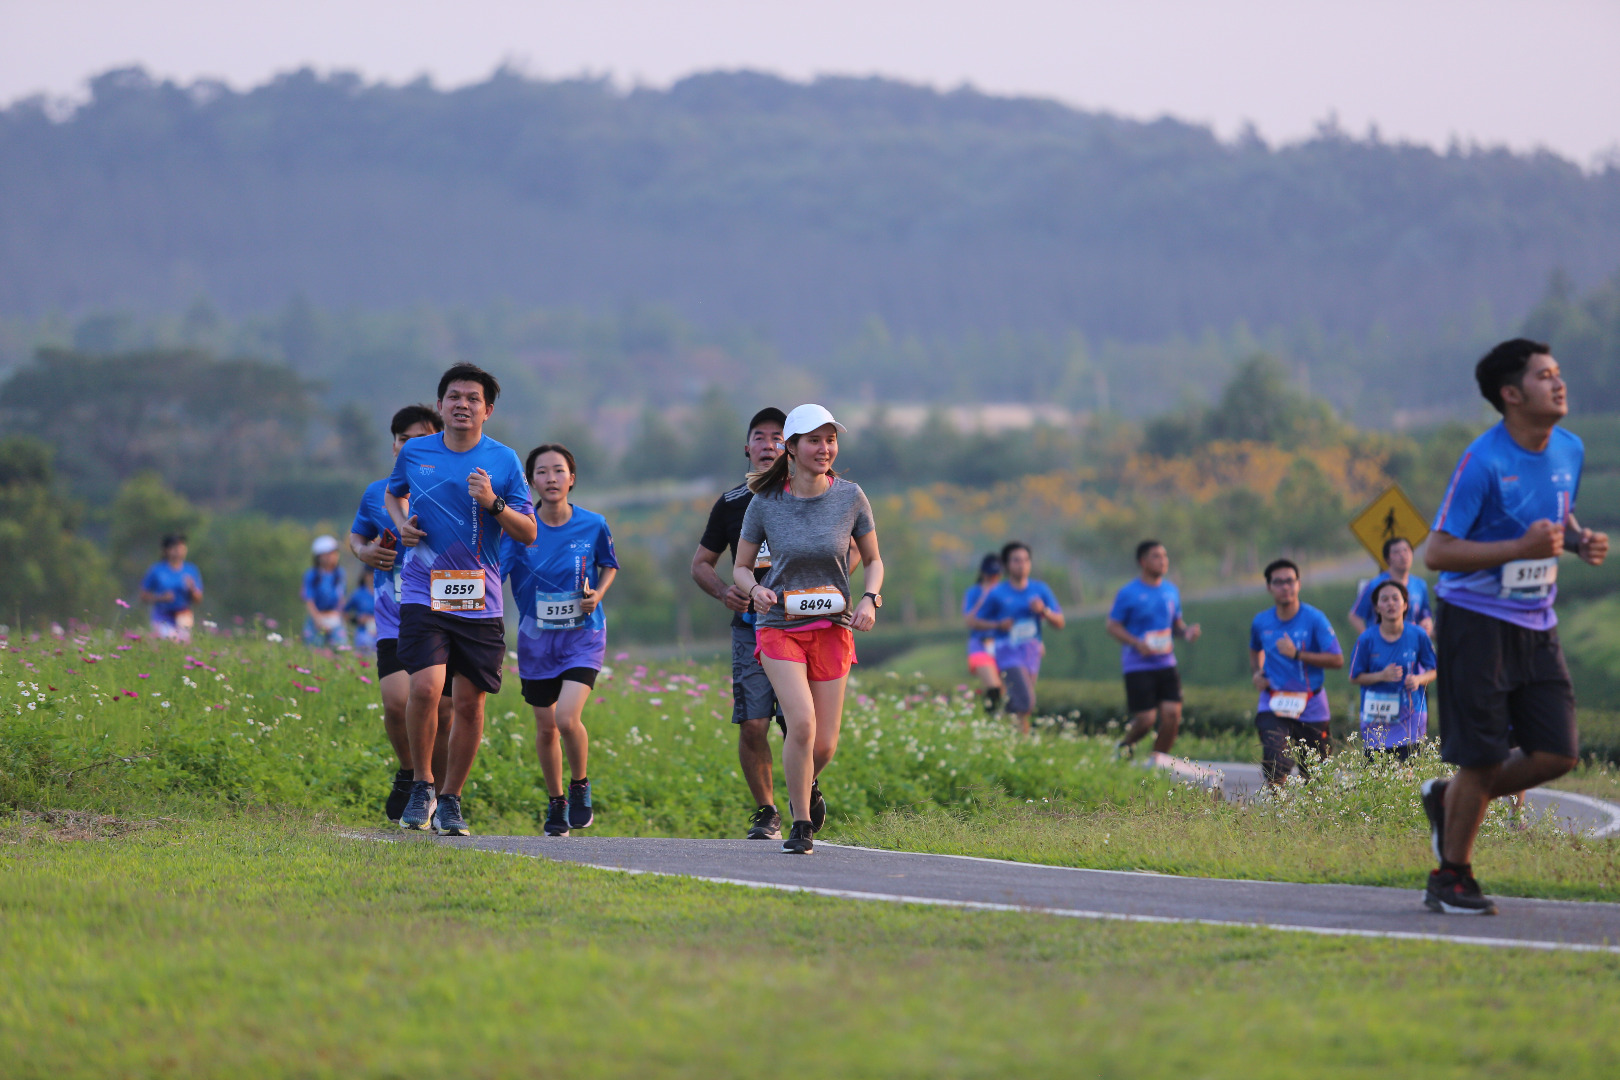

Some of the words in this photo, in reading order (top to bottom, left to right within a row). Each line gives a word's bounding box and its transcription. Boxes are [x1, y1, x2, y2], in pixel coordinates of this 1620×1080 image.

[1517, 565, 1548, 582] 5101
[444, 584, 475, 595] 8559
[546, 604, 574, 616] 5153
[800, 599, 832, 611] 8494
